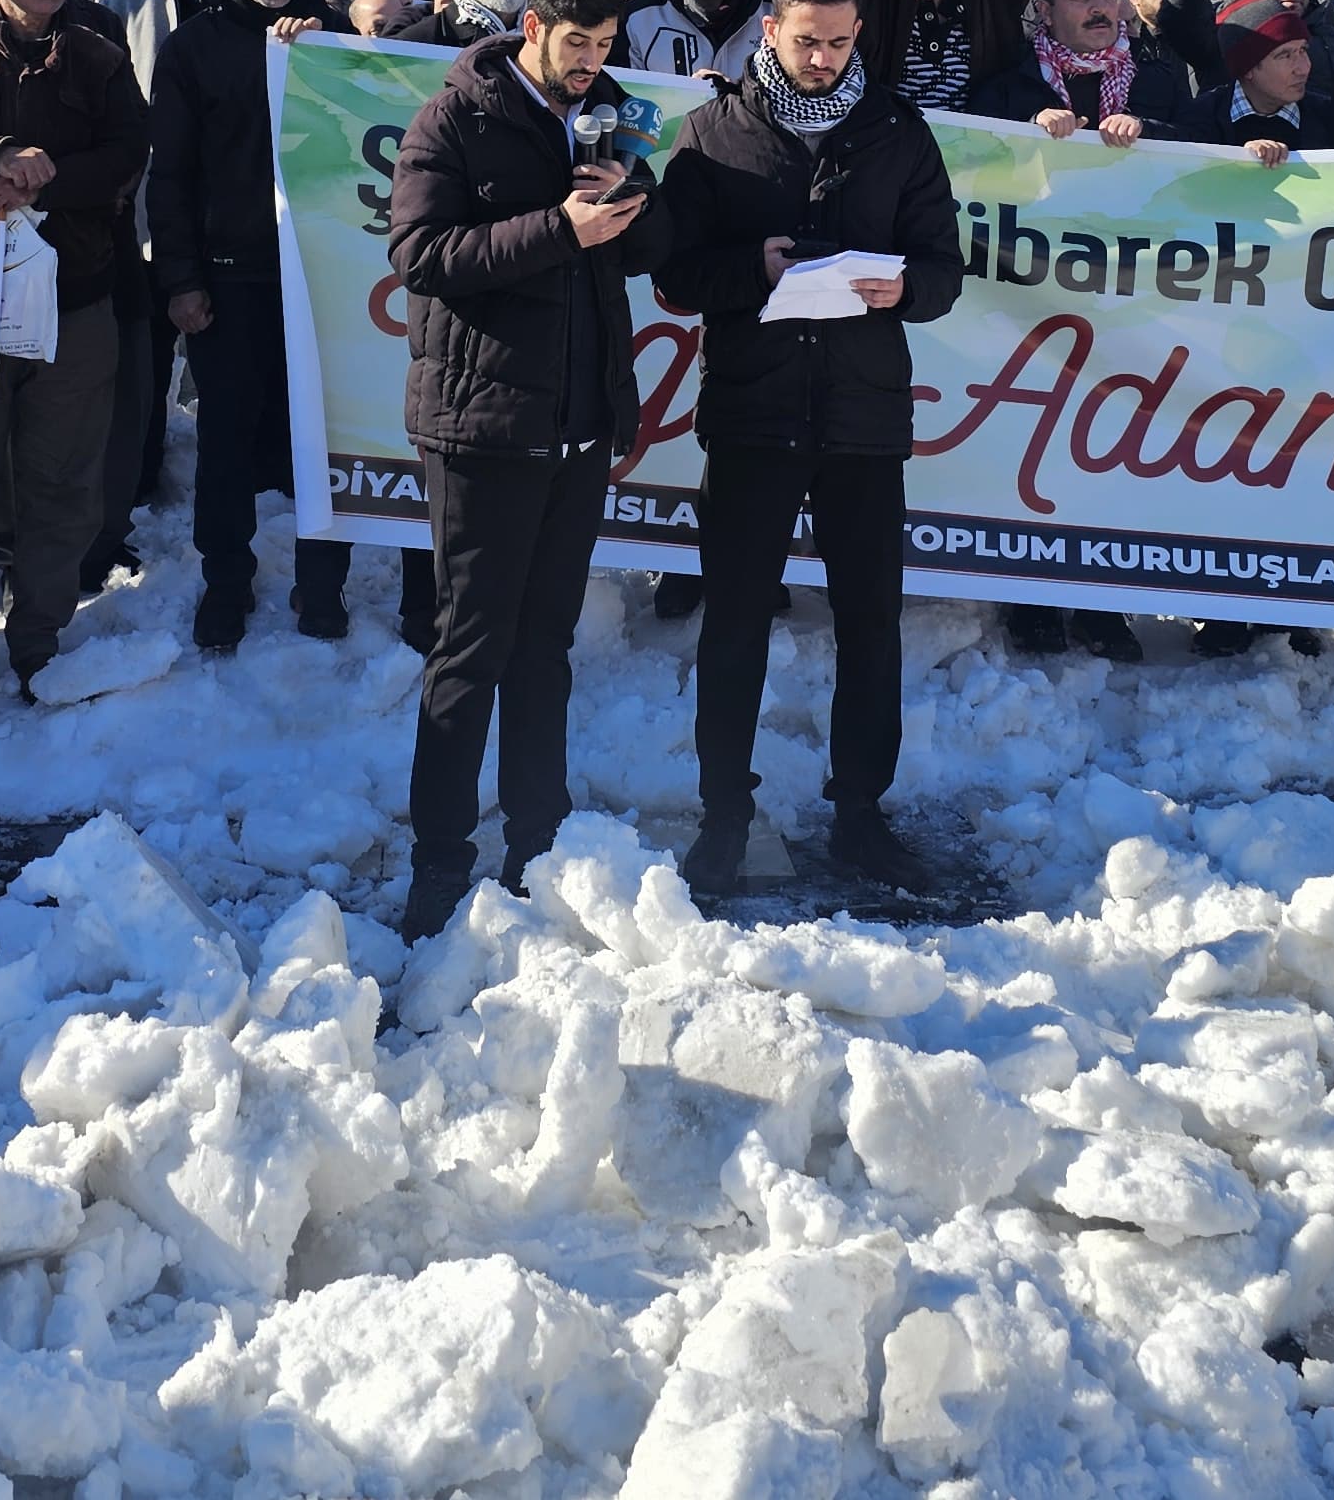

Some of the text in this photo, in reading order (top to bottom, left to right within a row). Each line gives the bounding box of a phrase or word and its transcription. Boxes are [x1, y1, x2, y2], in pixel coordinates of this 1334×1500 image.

[957, 201, 1271, 307] übarek
[327, 460, 429, 502] DİYA
[603, 485, 699, 529] İSLA
